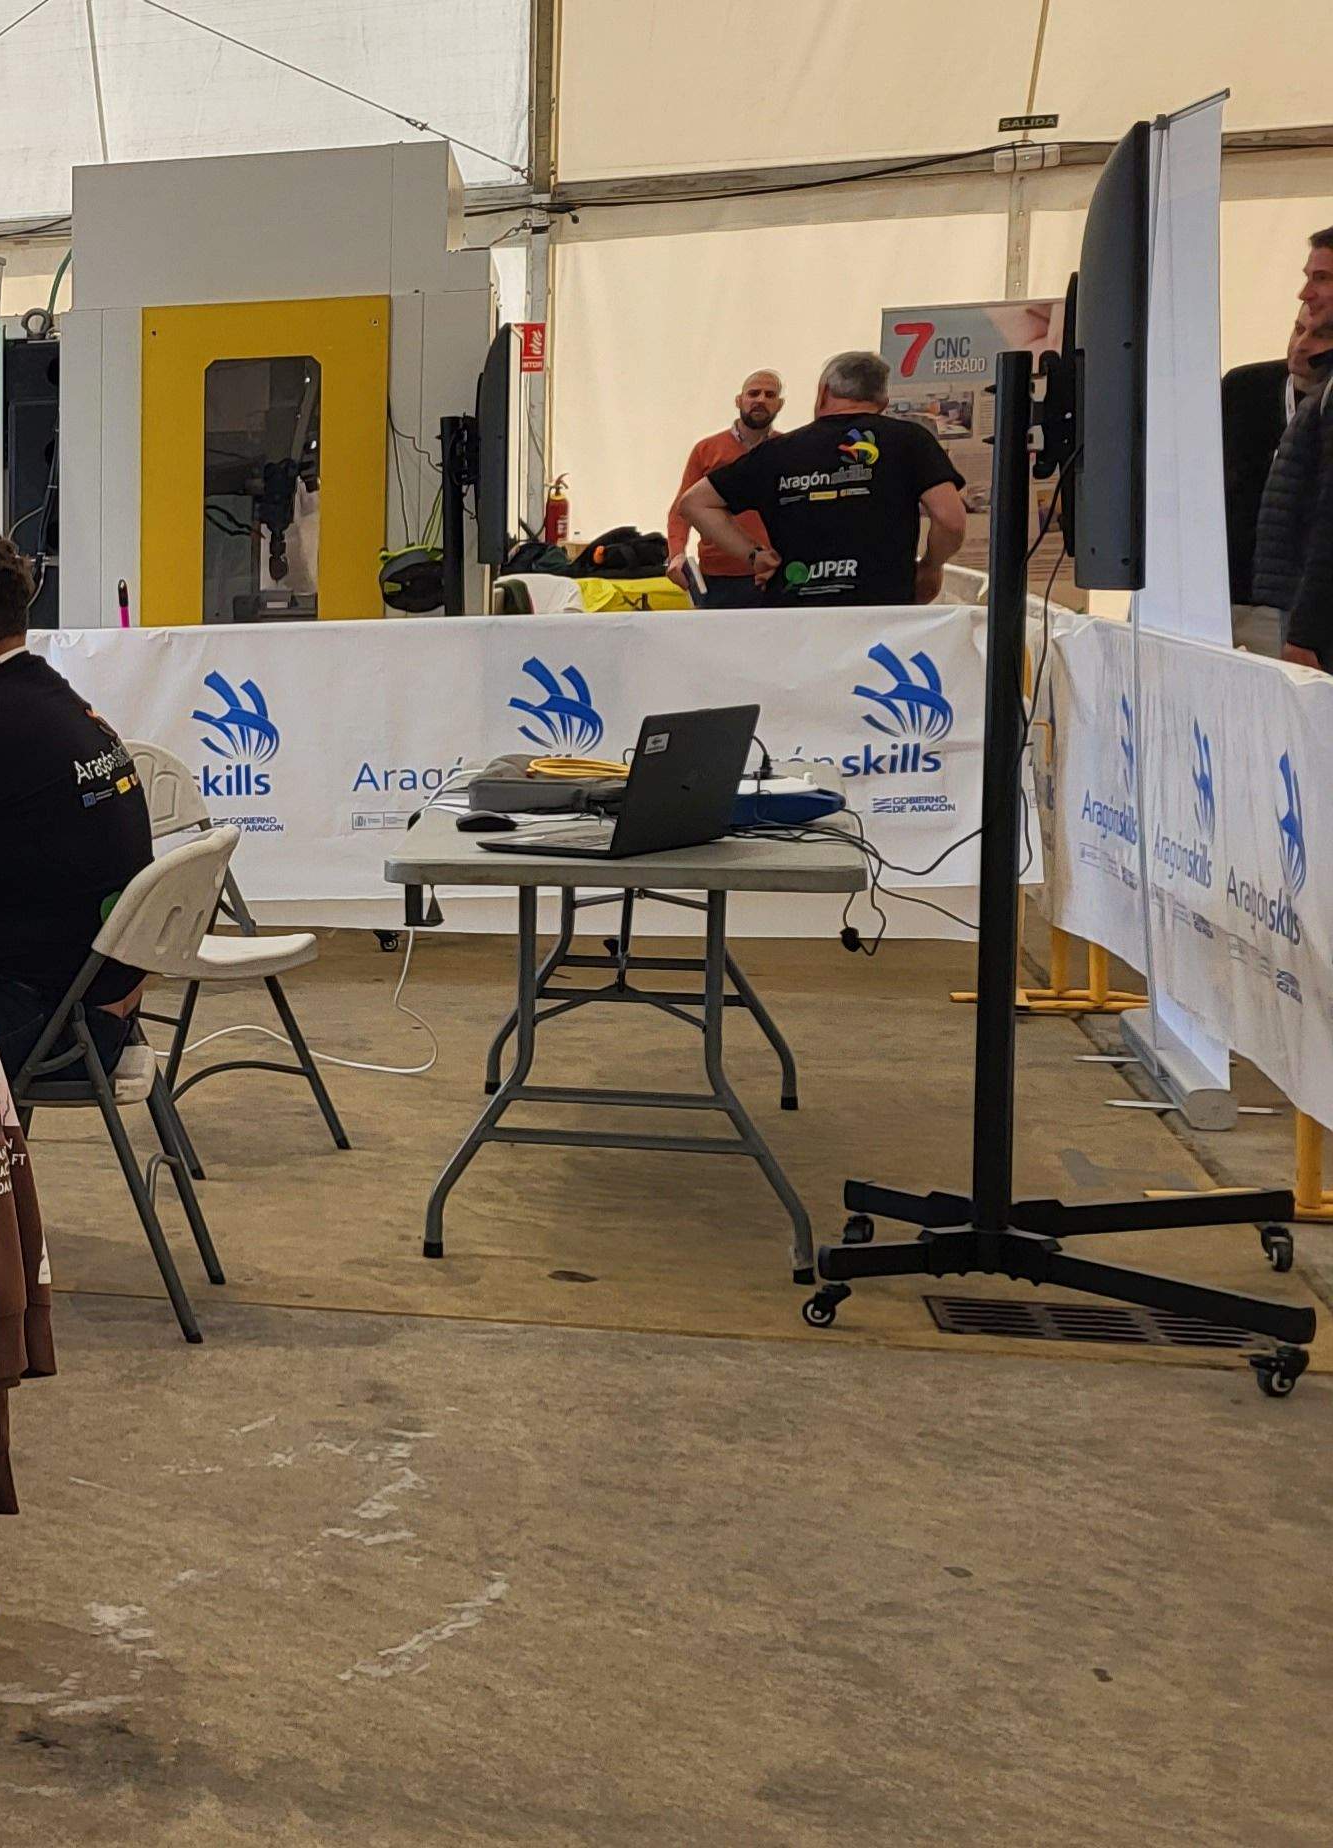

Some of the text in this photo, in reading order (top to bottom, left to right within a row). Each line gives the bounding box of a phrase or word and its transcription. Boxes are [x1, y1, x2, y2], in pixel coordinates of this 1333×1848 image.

[1000, 118, 1056, 129] SALIDA
[894, 322, 971, 378] 7 CNC
[933, 358, 987, 375] FRESADO
[194, 764, 272, 797] kills
[892, 795, 948, 805] GOBIERNO
[892, 804, 905, 813] DE
[229, 816, 278, 825] GOBIERNO
